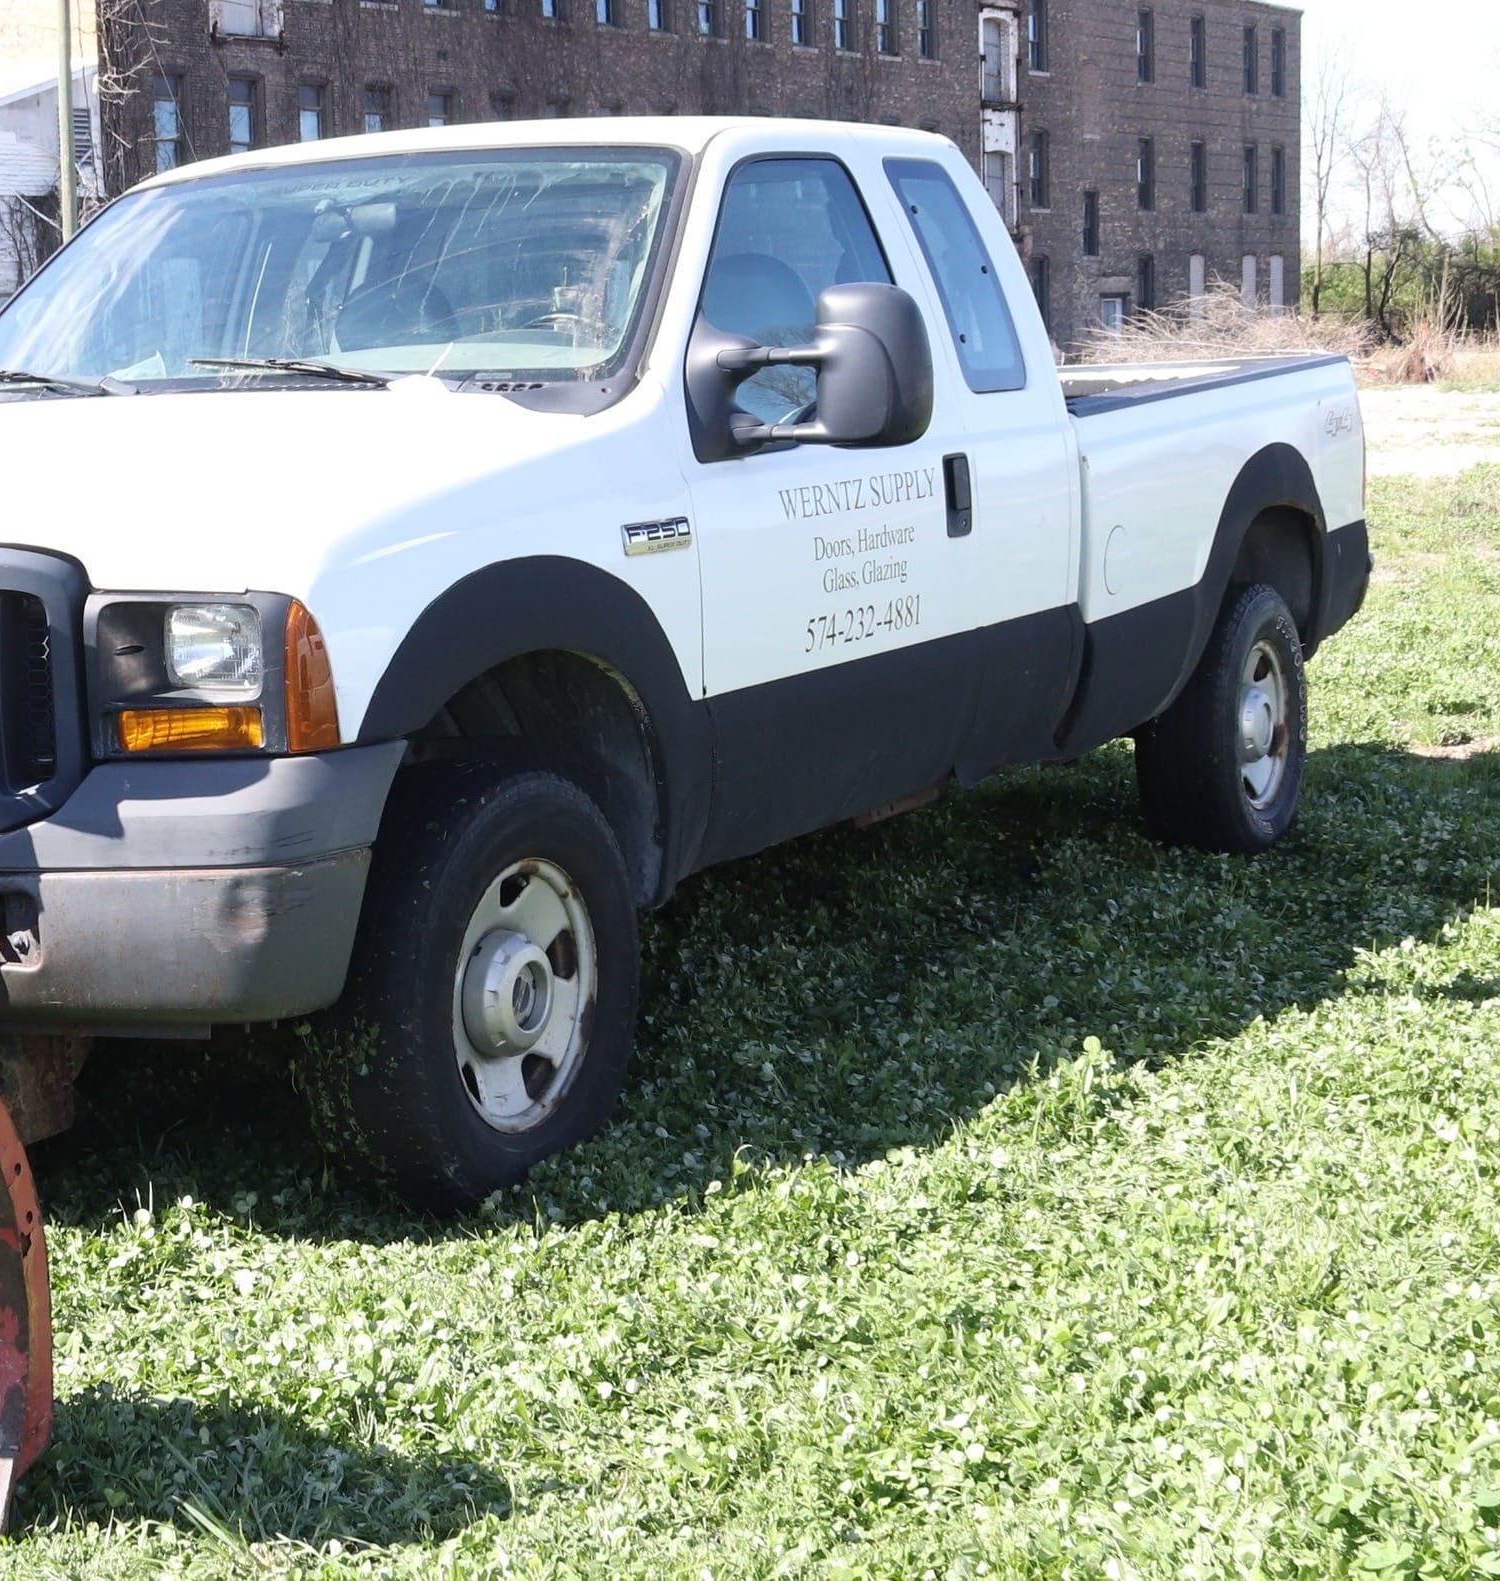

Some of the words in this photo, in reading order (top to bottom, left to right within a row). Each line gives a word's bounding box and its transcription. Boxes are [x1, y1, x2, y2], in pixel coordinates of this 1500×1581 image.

[778, 478, 866, 521] WERNTZ
[868, 467, 936, 507] SUPPLY
[813, 536, 855, 561] Doors,
[857, 524, 915, 558] Hardware
[822, 567, 860, 594] Glass,
[861, 555, 908, 584] Glazing
[805, 593, 921, 653] 574-232-4881
